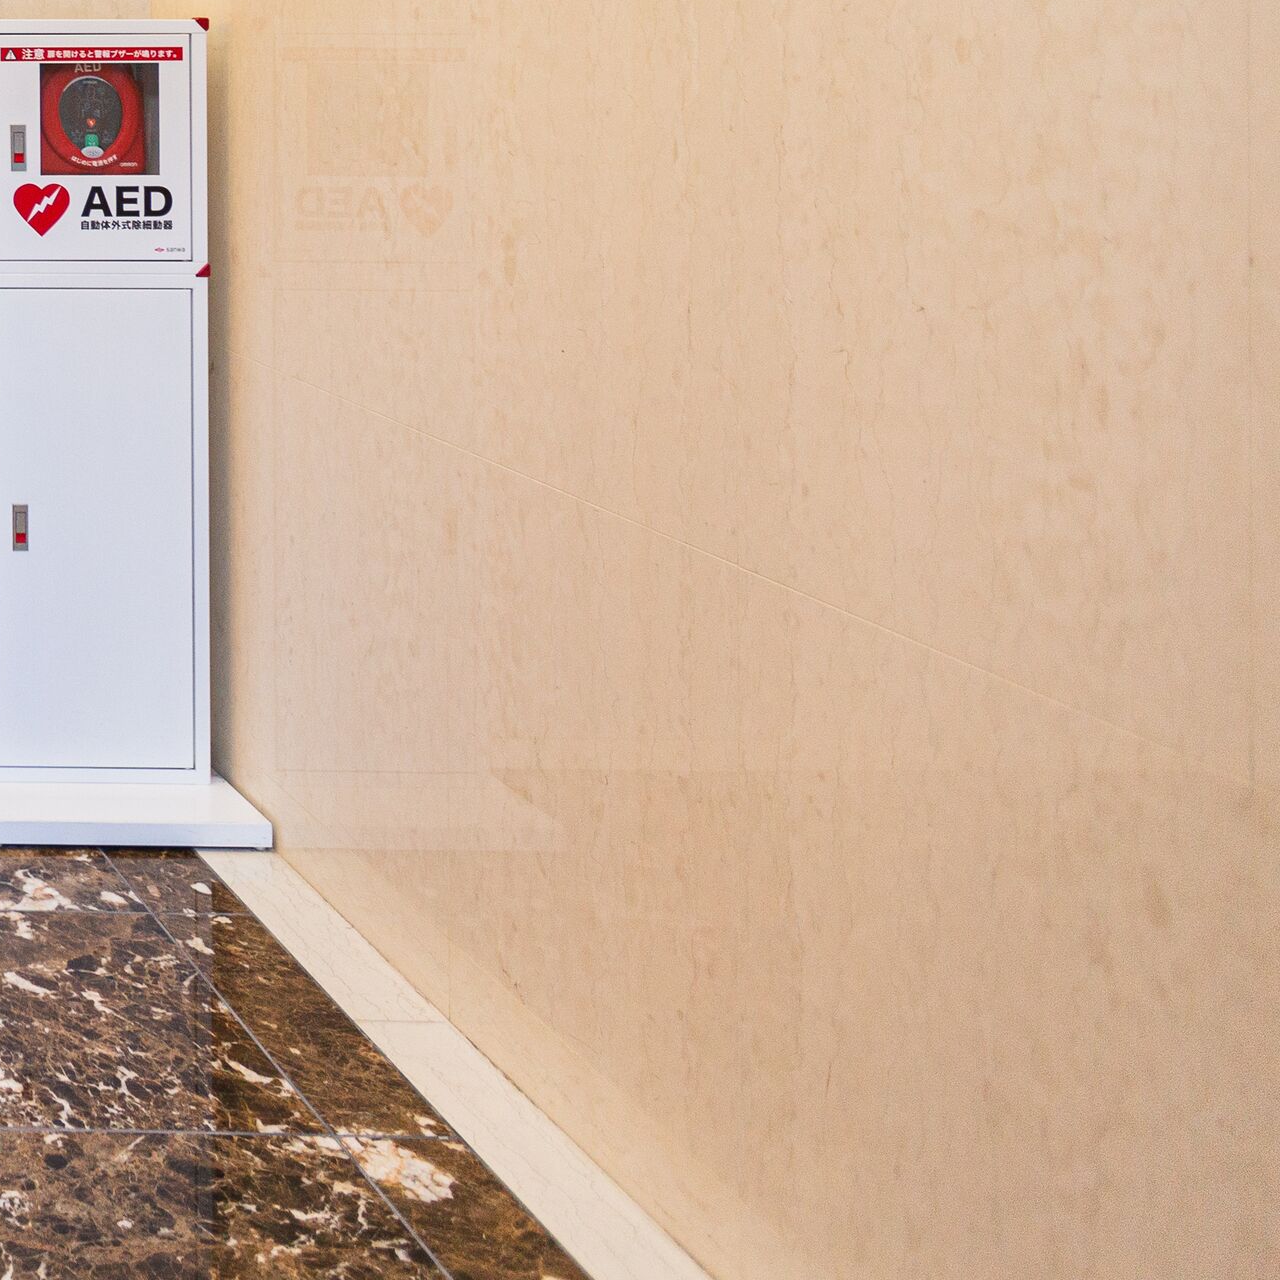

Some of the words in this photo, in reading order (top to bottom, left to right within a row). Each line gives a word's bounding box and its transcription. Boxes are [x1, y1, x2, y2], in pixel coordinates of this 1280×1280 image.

[21, 48, 45, 60] 注意
[74, 63, 102, 73] AED
[81, 186, 173, 217] AED
[81, 220, 173, 230] 自動体外式除細動器
